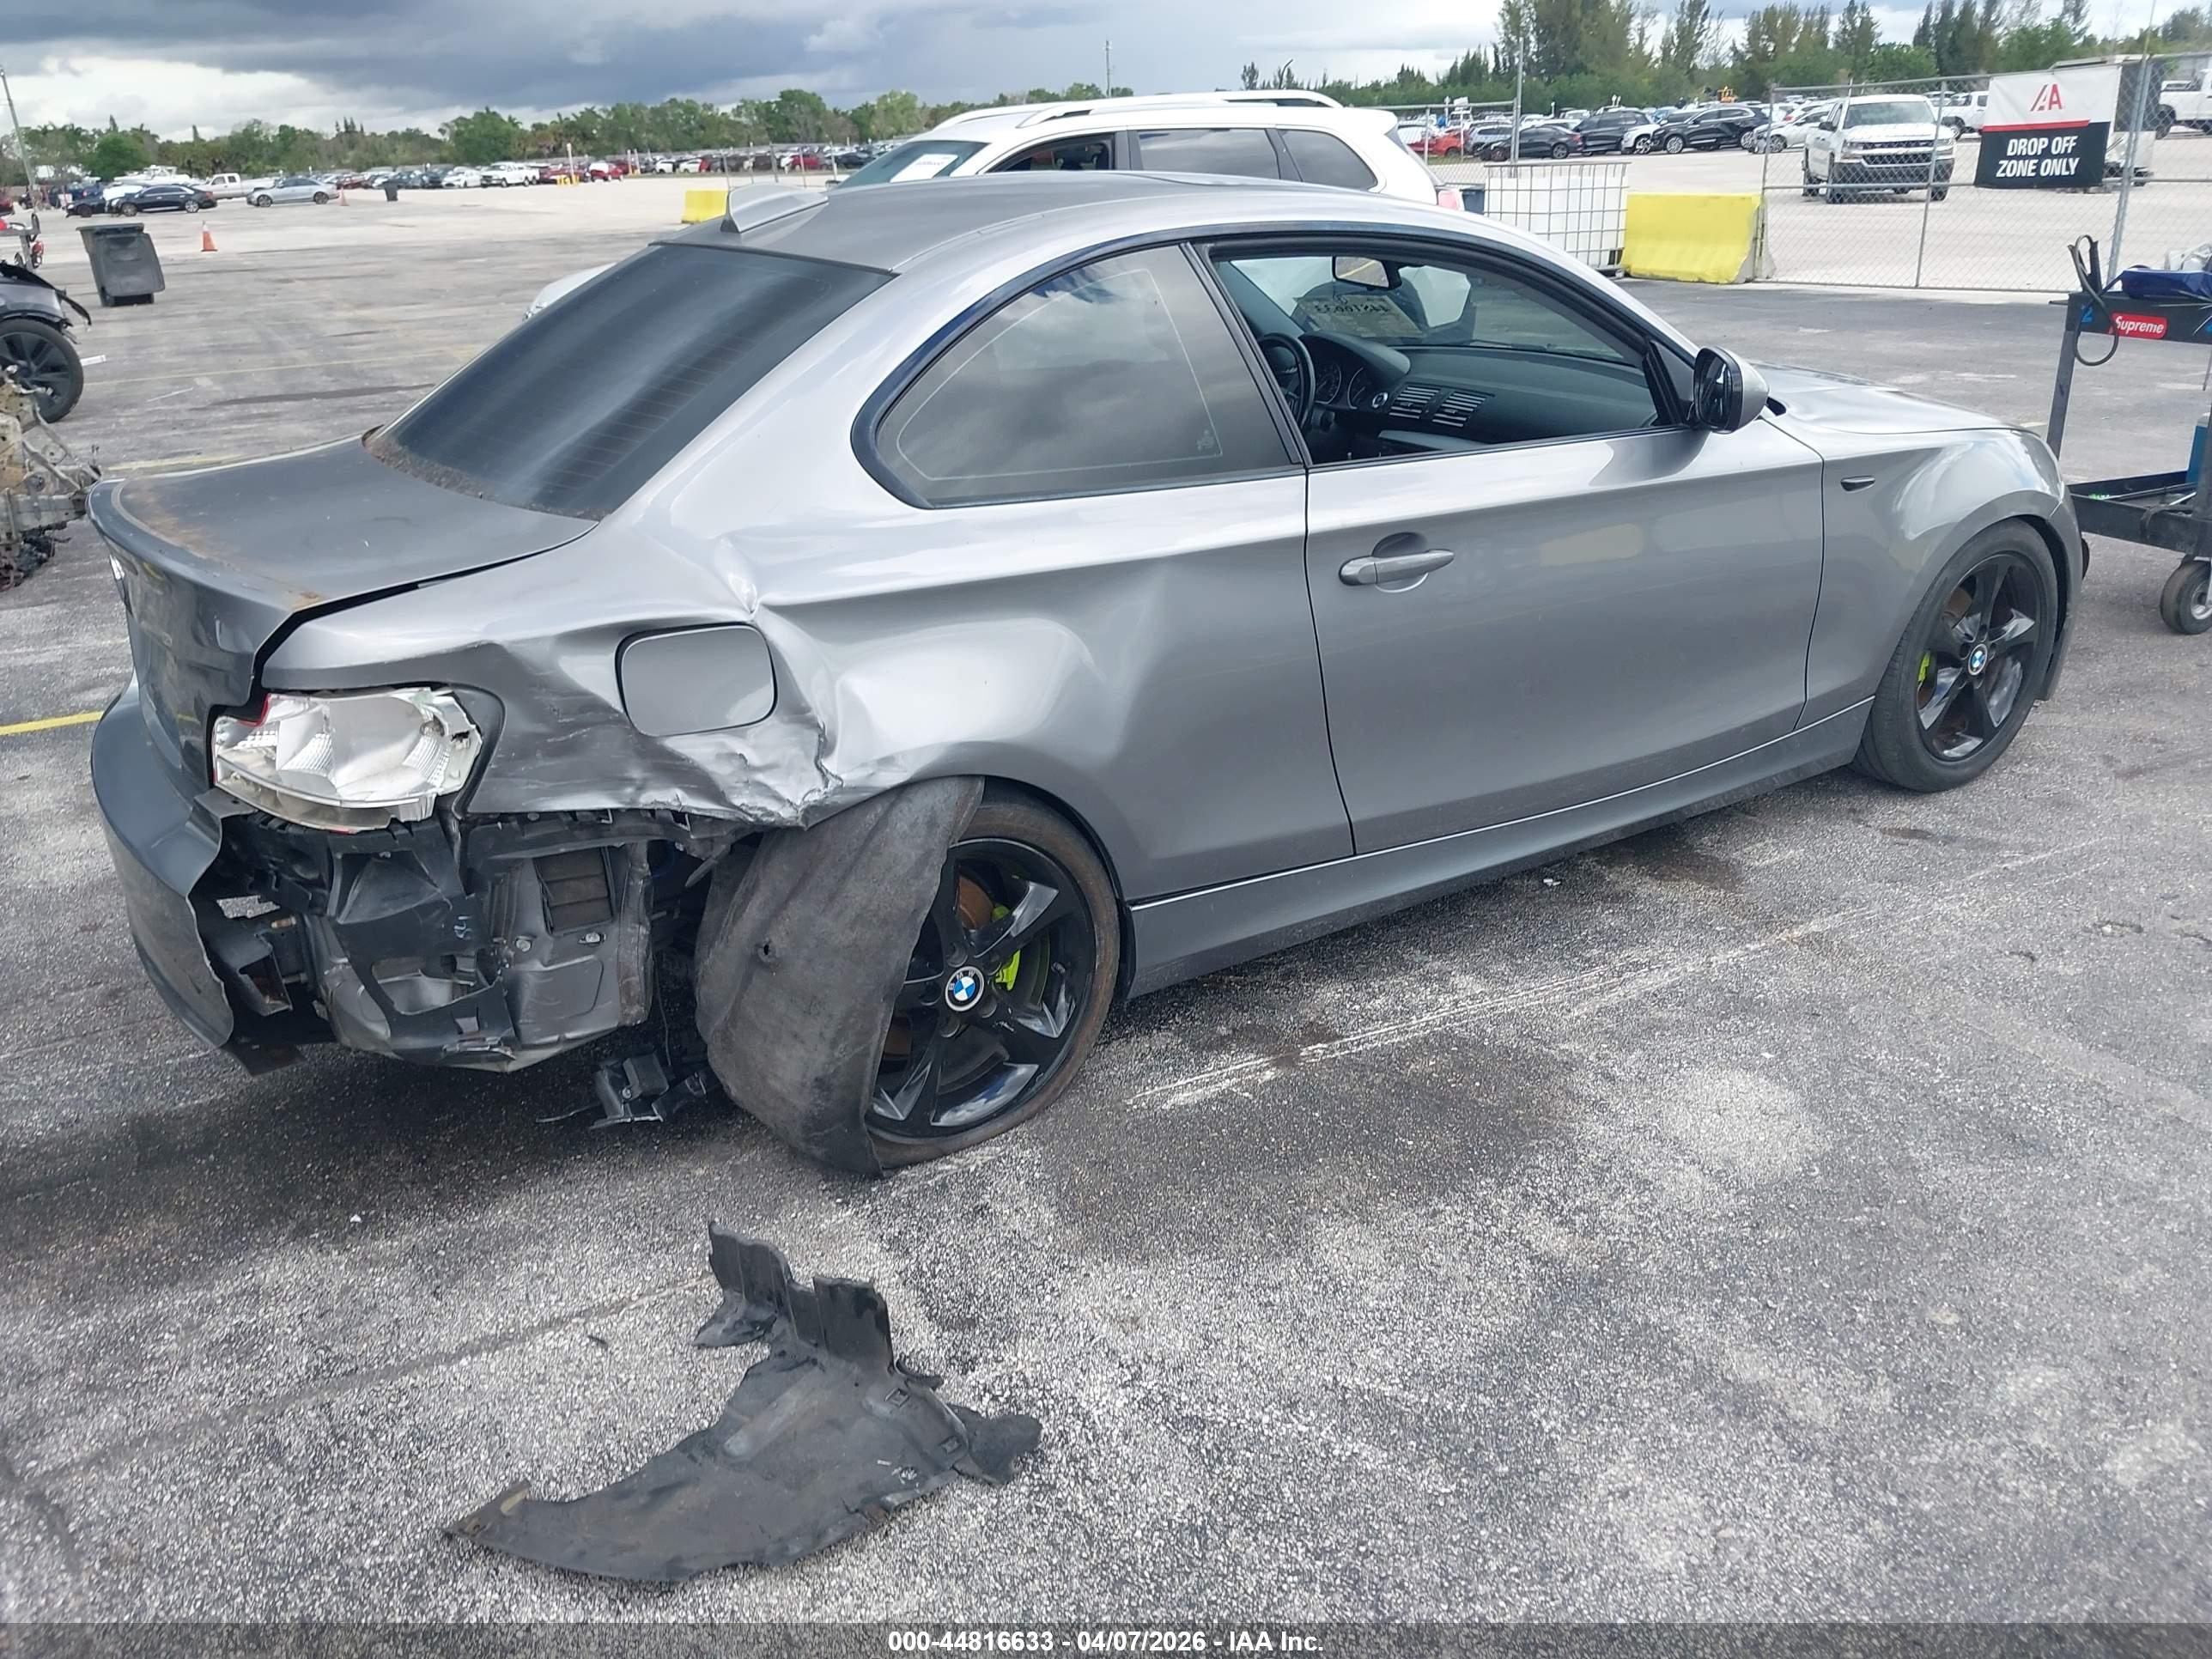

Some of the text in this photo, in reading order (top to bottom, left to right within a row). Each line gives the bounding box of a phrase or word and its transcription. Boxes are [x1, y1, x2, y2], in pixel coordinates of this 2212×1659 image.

[2006, 136, 2078, 156] DROP OFF
[1996, 157, 2080, 178] ZONE ONLY
[2115, 315, 2165, 335] Supreme
[948, 969, 975, 991] BMW
